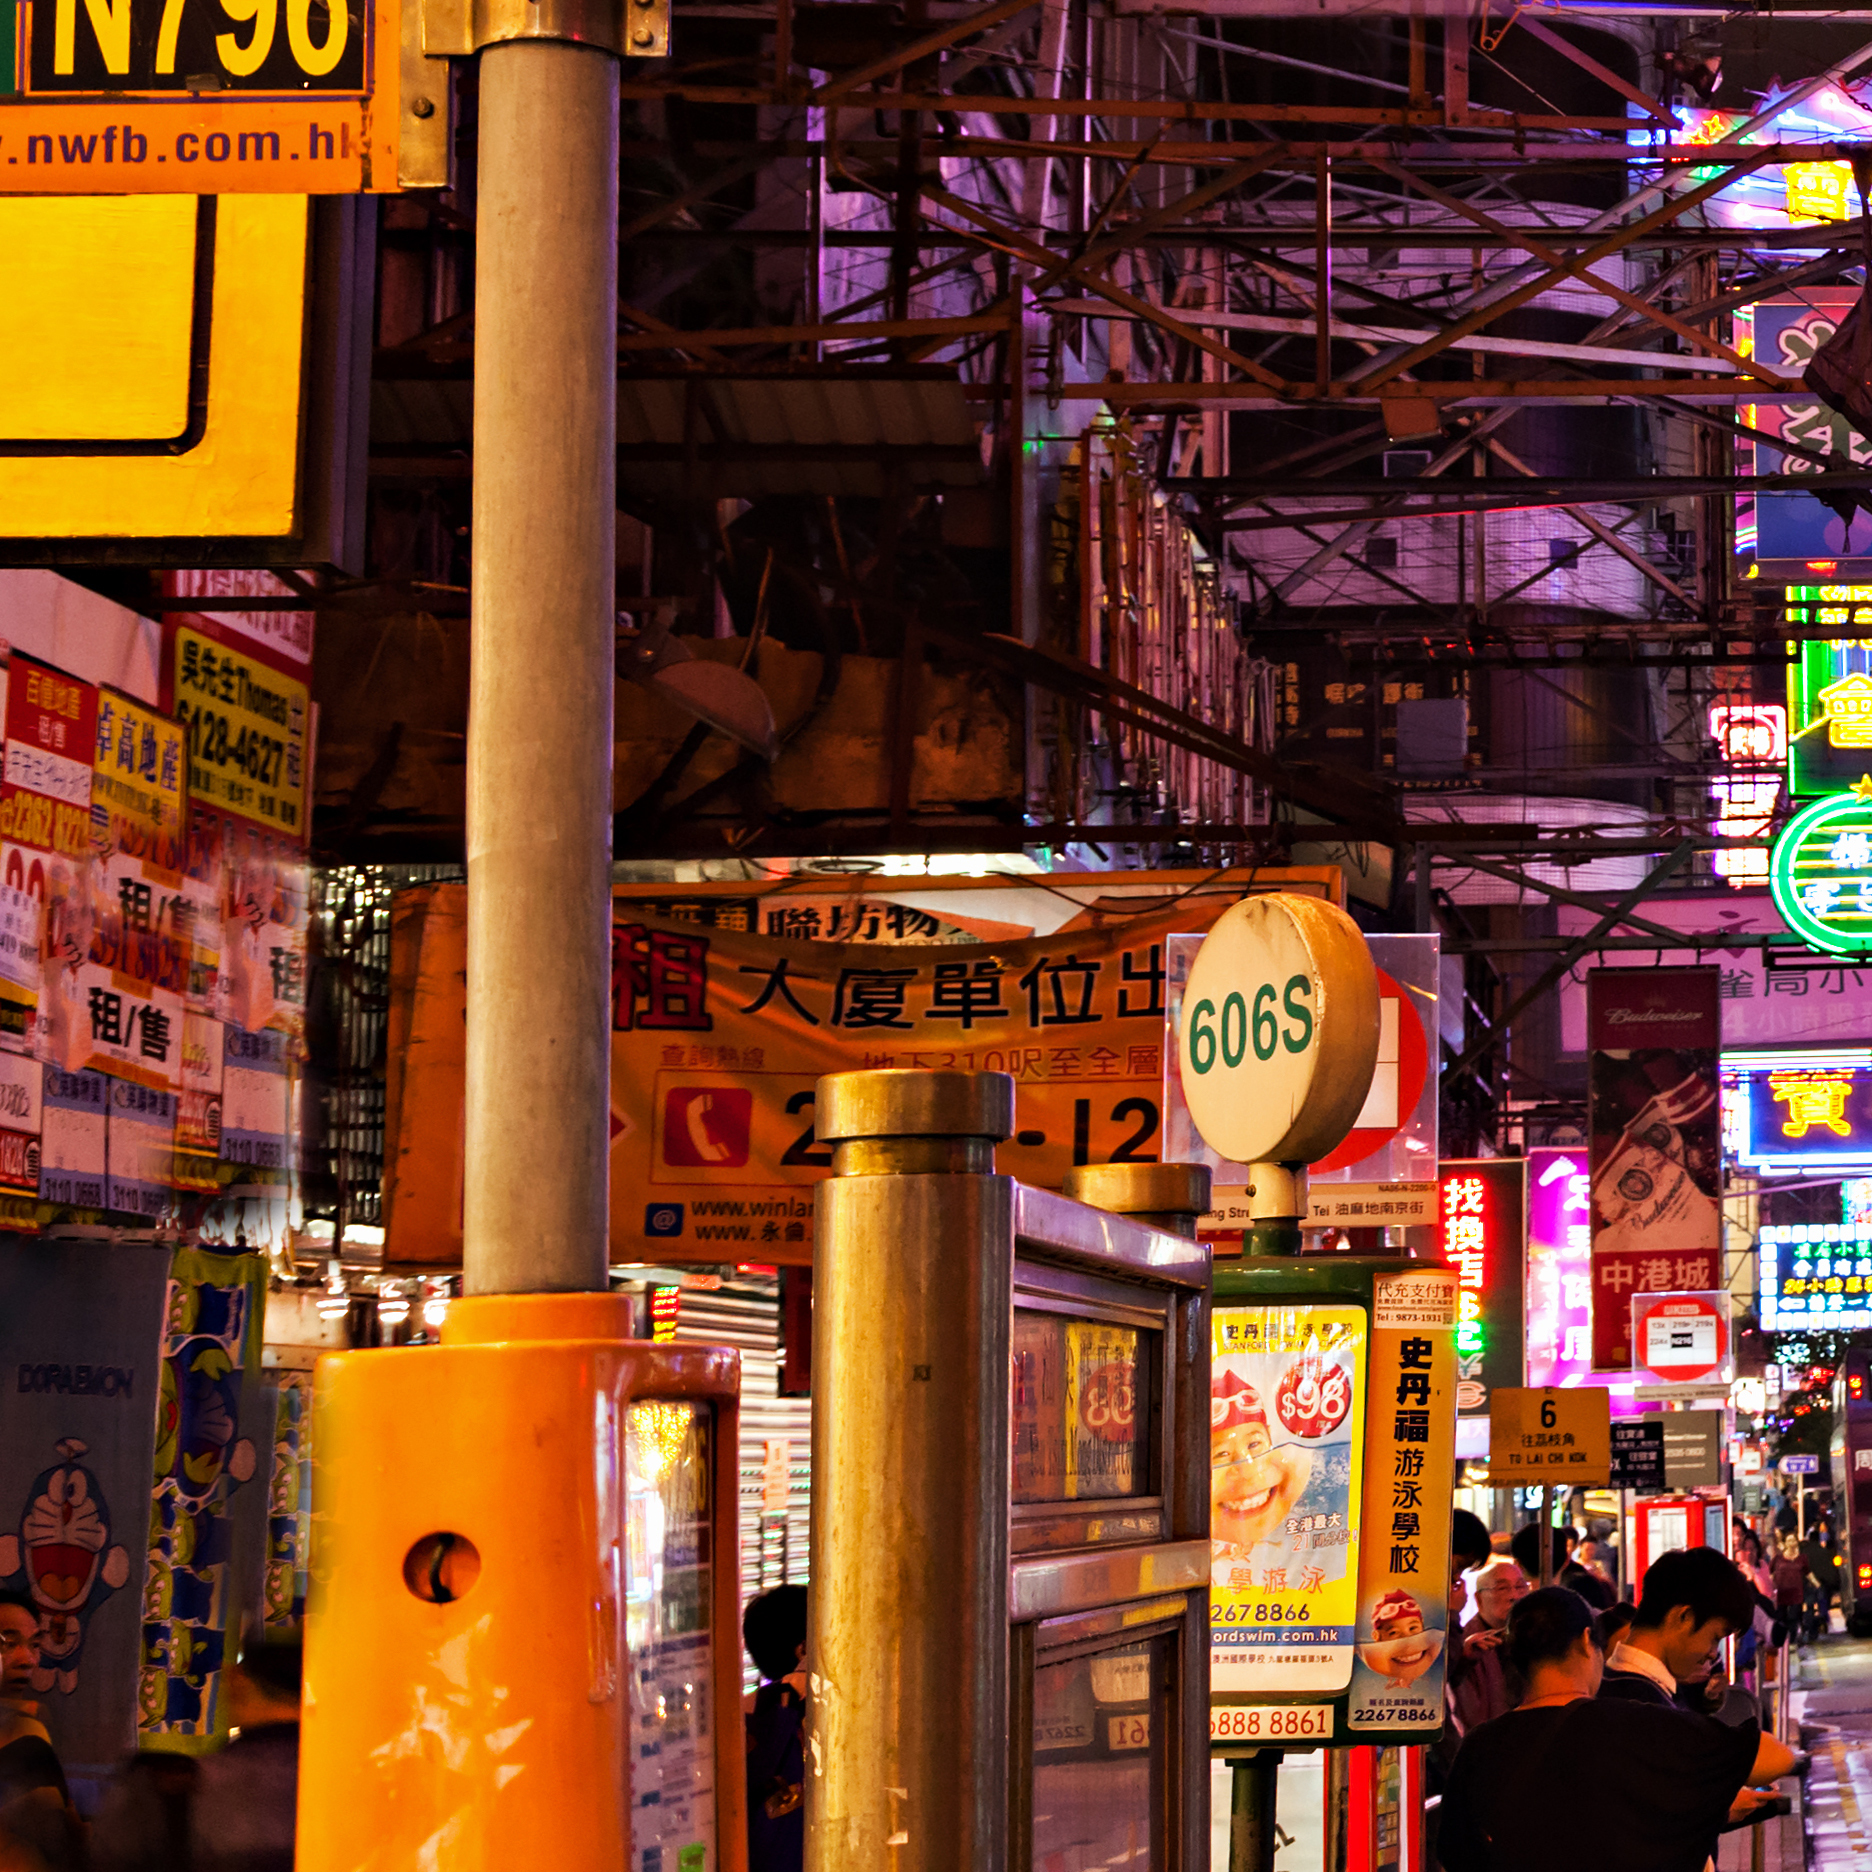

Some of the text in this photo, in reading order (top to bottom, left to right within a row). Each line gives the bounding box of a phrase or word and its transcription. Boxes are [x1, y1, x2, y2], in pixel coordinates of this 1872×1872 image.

[1189, 974, 1313, 1075] 606S
[1605, 1006, 1704, 1025] Budweiser
[1313, 1204, 1331, 1217] Tei
[1335, 1201, 1424, 1216] 油麻地南京街
[1601, 1258, 1711, 1294] 中港城
[1378, 1282, 1455, 1298] 代充支付寶
[1396, 1313, 1441, 1322] 9873-1931
[18, 1363, 133, 1398] DORAEMON
[1281, 1379, 1346, 1420] $98
[1541, 1400, 1557, 1428] 6
[1521, 1433, 1575, 1447] 往荔枝角
[1390, 1336, 1433, 1574] 史丹福游泳學校
[1509, 1452, 1587, 1464] TO LAI CHI KOK
[1286, 1513, 1342, 1535] 全港最大
[1211, 1564, 1326, 1596] 學游泳
[1213, 1629, 1338, 1644] ordswim.com.hk
[1270, 1709, 1326, 1735] 8861
[1354, 1708, 1436, 1722] 2267 8866
